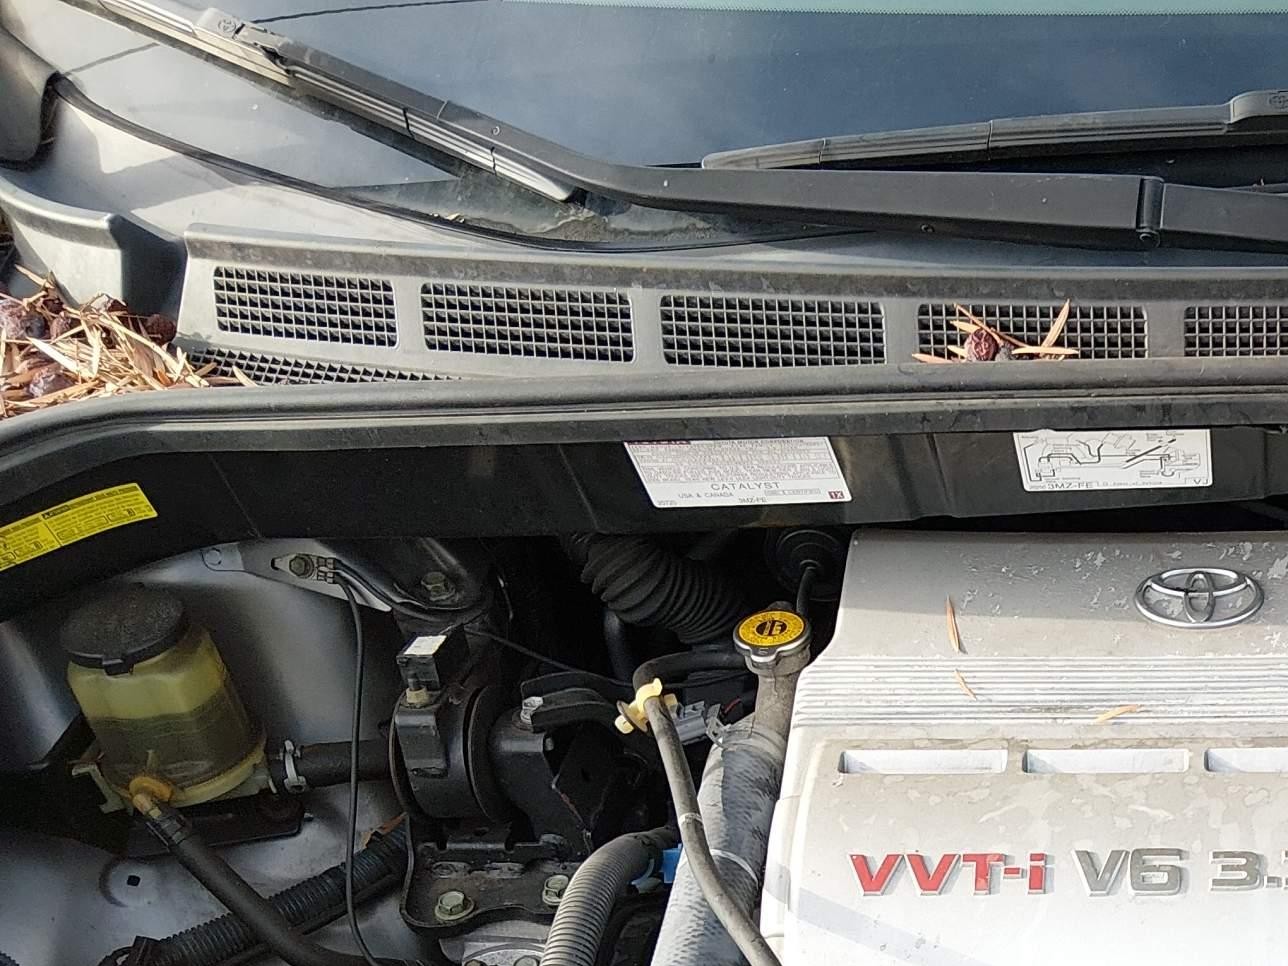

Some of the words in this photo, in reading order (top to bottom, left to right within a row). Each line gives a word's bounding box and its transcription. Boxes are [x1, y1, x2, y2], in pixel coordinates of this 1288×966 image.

[709, 481, 781, 491] CATALYST
[848, 851, 1047, 897] VVT-i
[1071, 848, 1189, 897] V6
